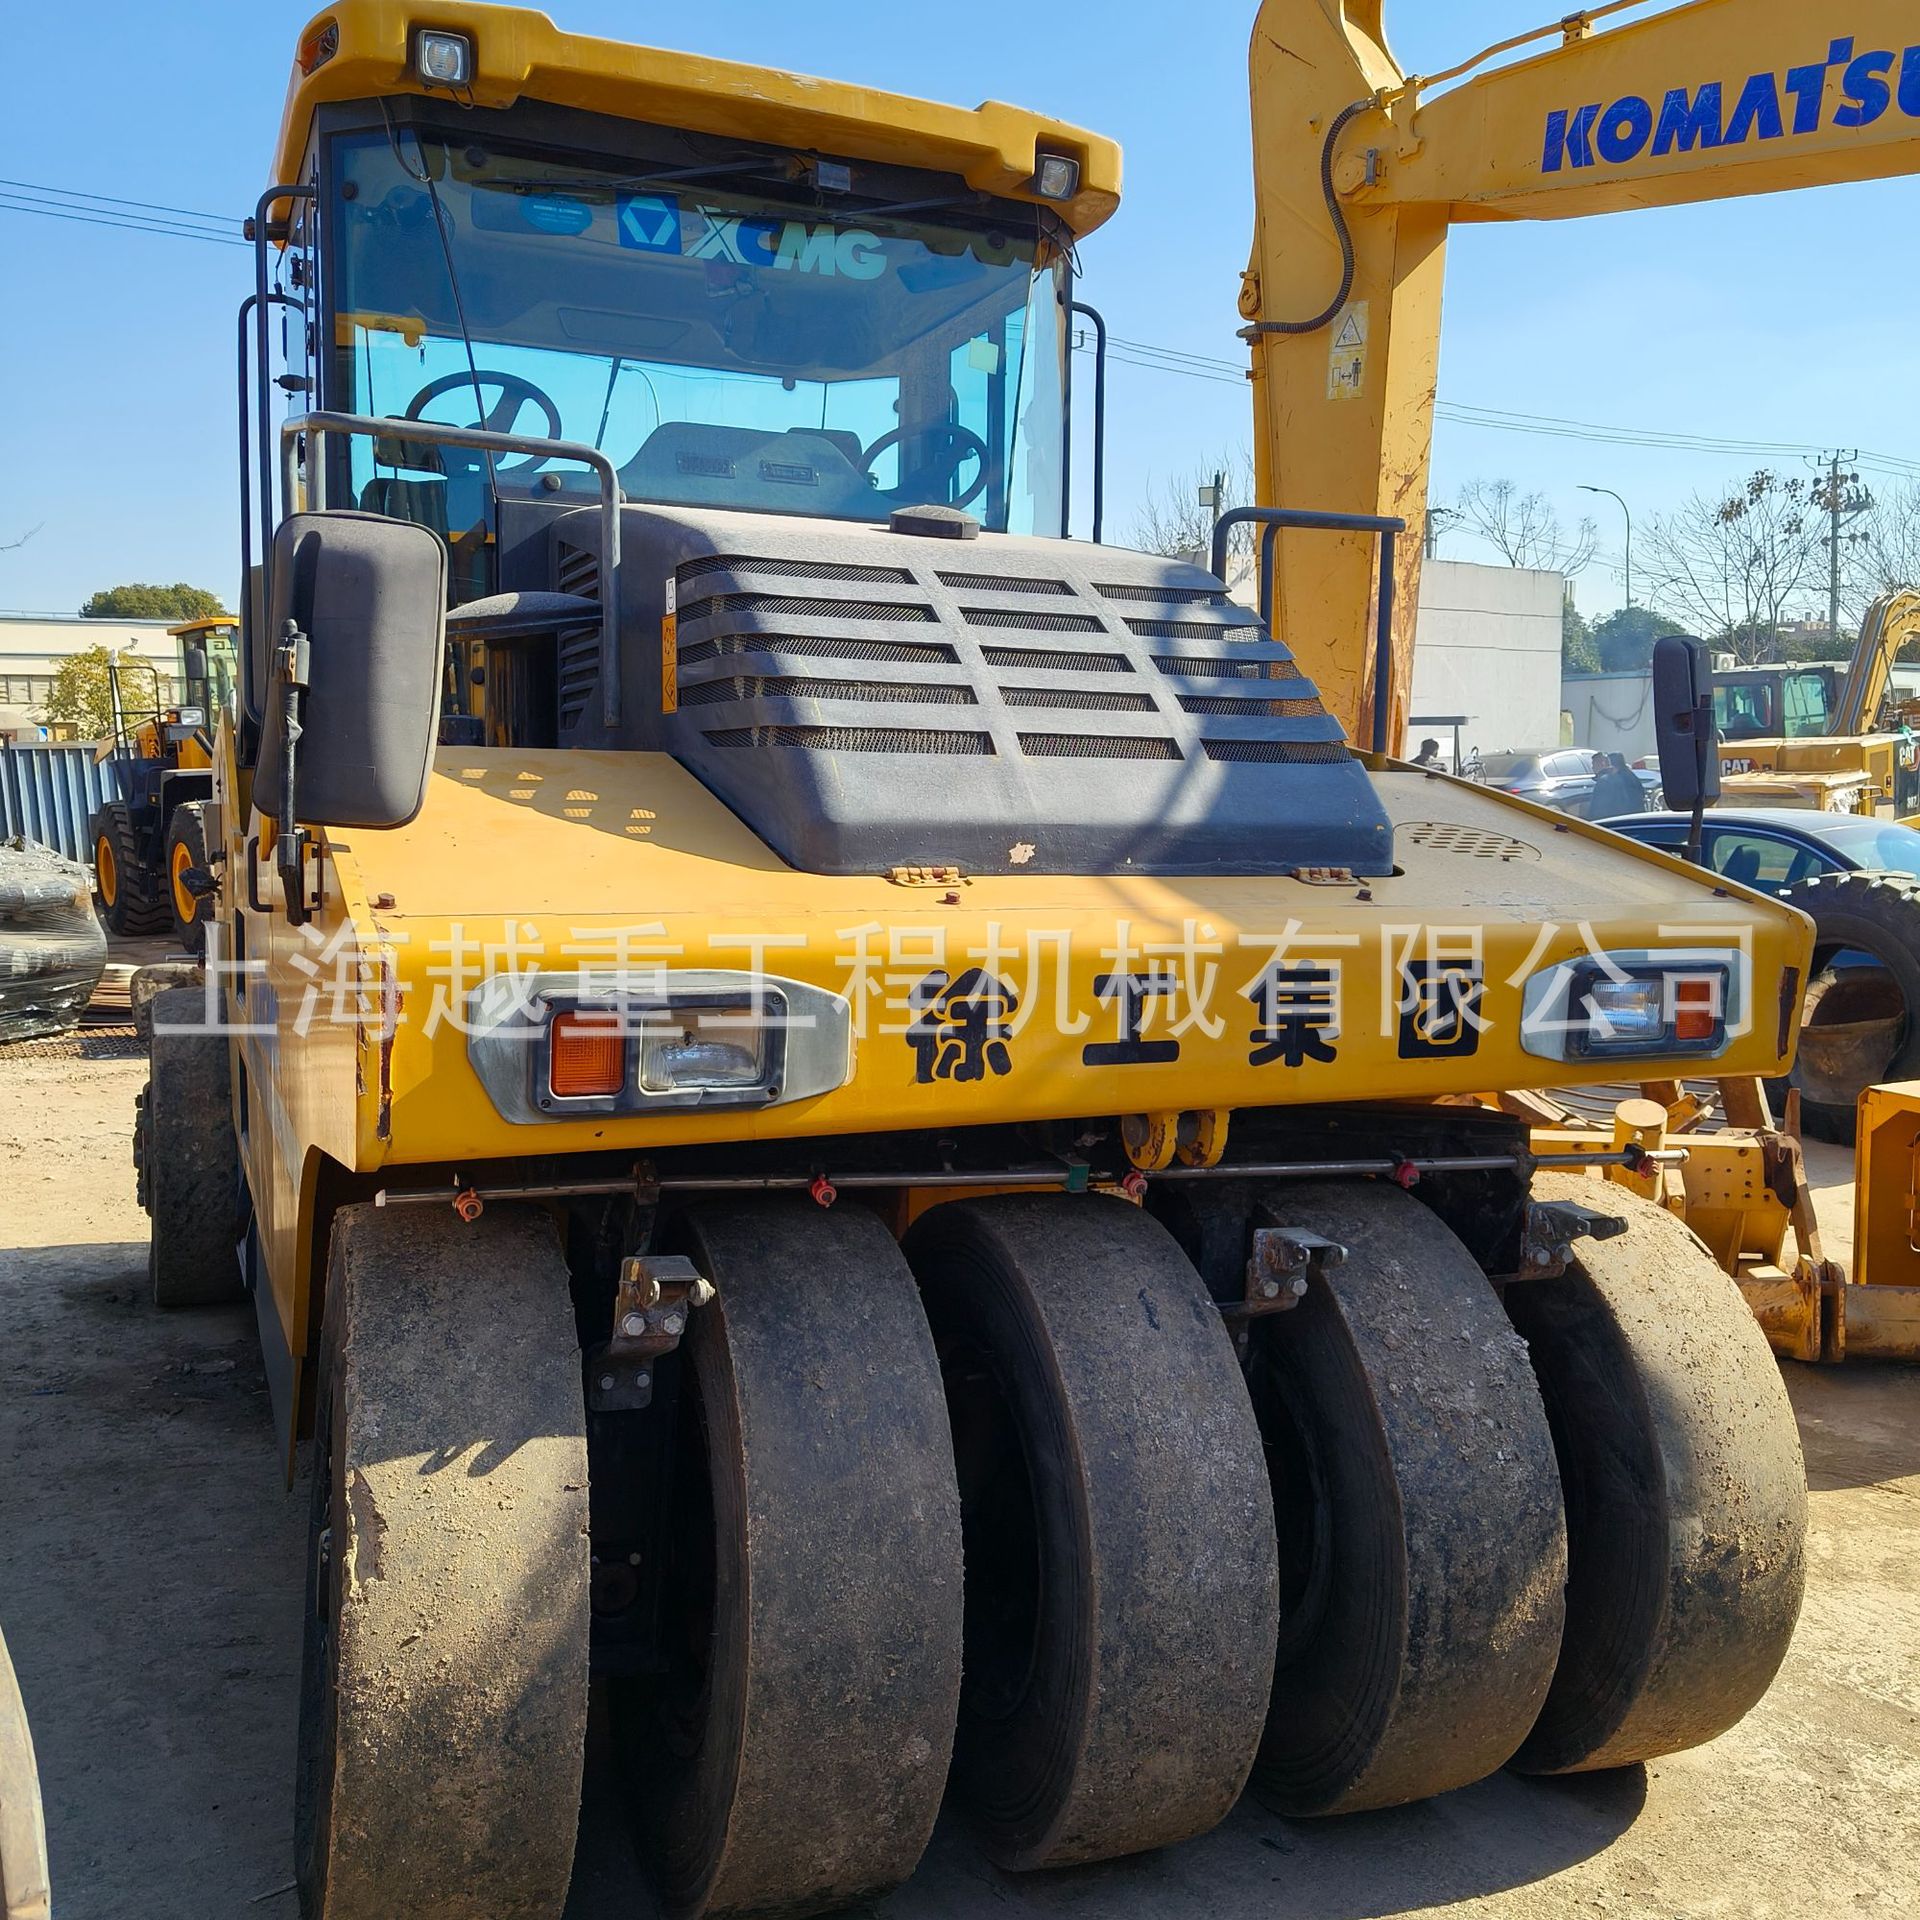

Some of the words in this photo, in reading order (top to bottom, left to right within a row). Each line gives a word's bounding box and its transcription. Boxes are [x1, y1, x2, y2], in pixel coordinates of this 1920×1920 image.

[683, 204, 887, 280] XCMG
[1721, 759, 1750, 777] CAT
[907, 959, 1485, 1084] 徐工集团
